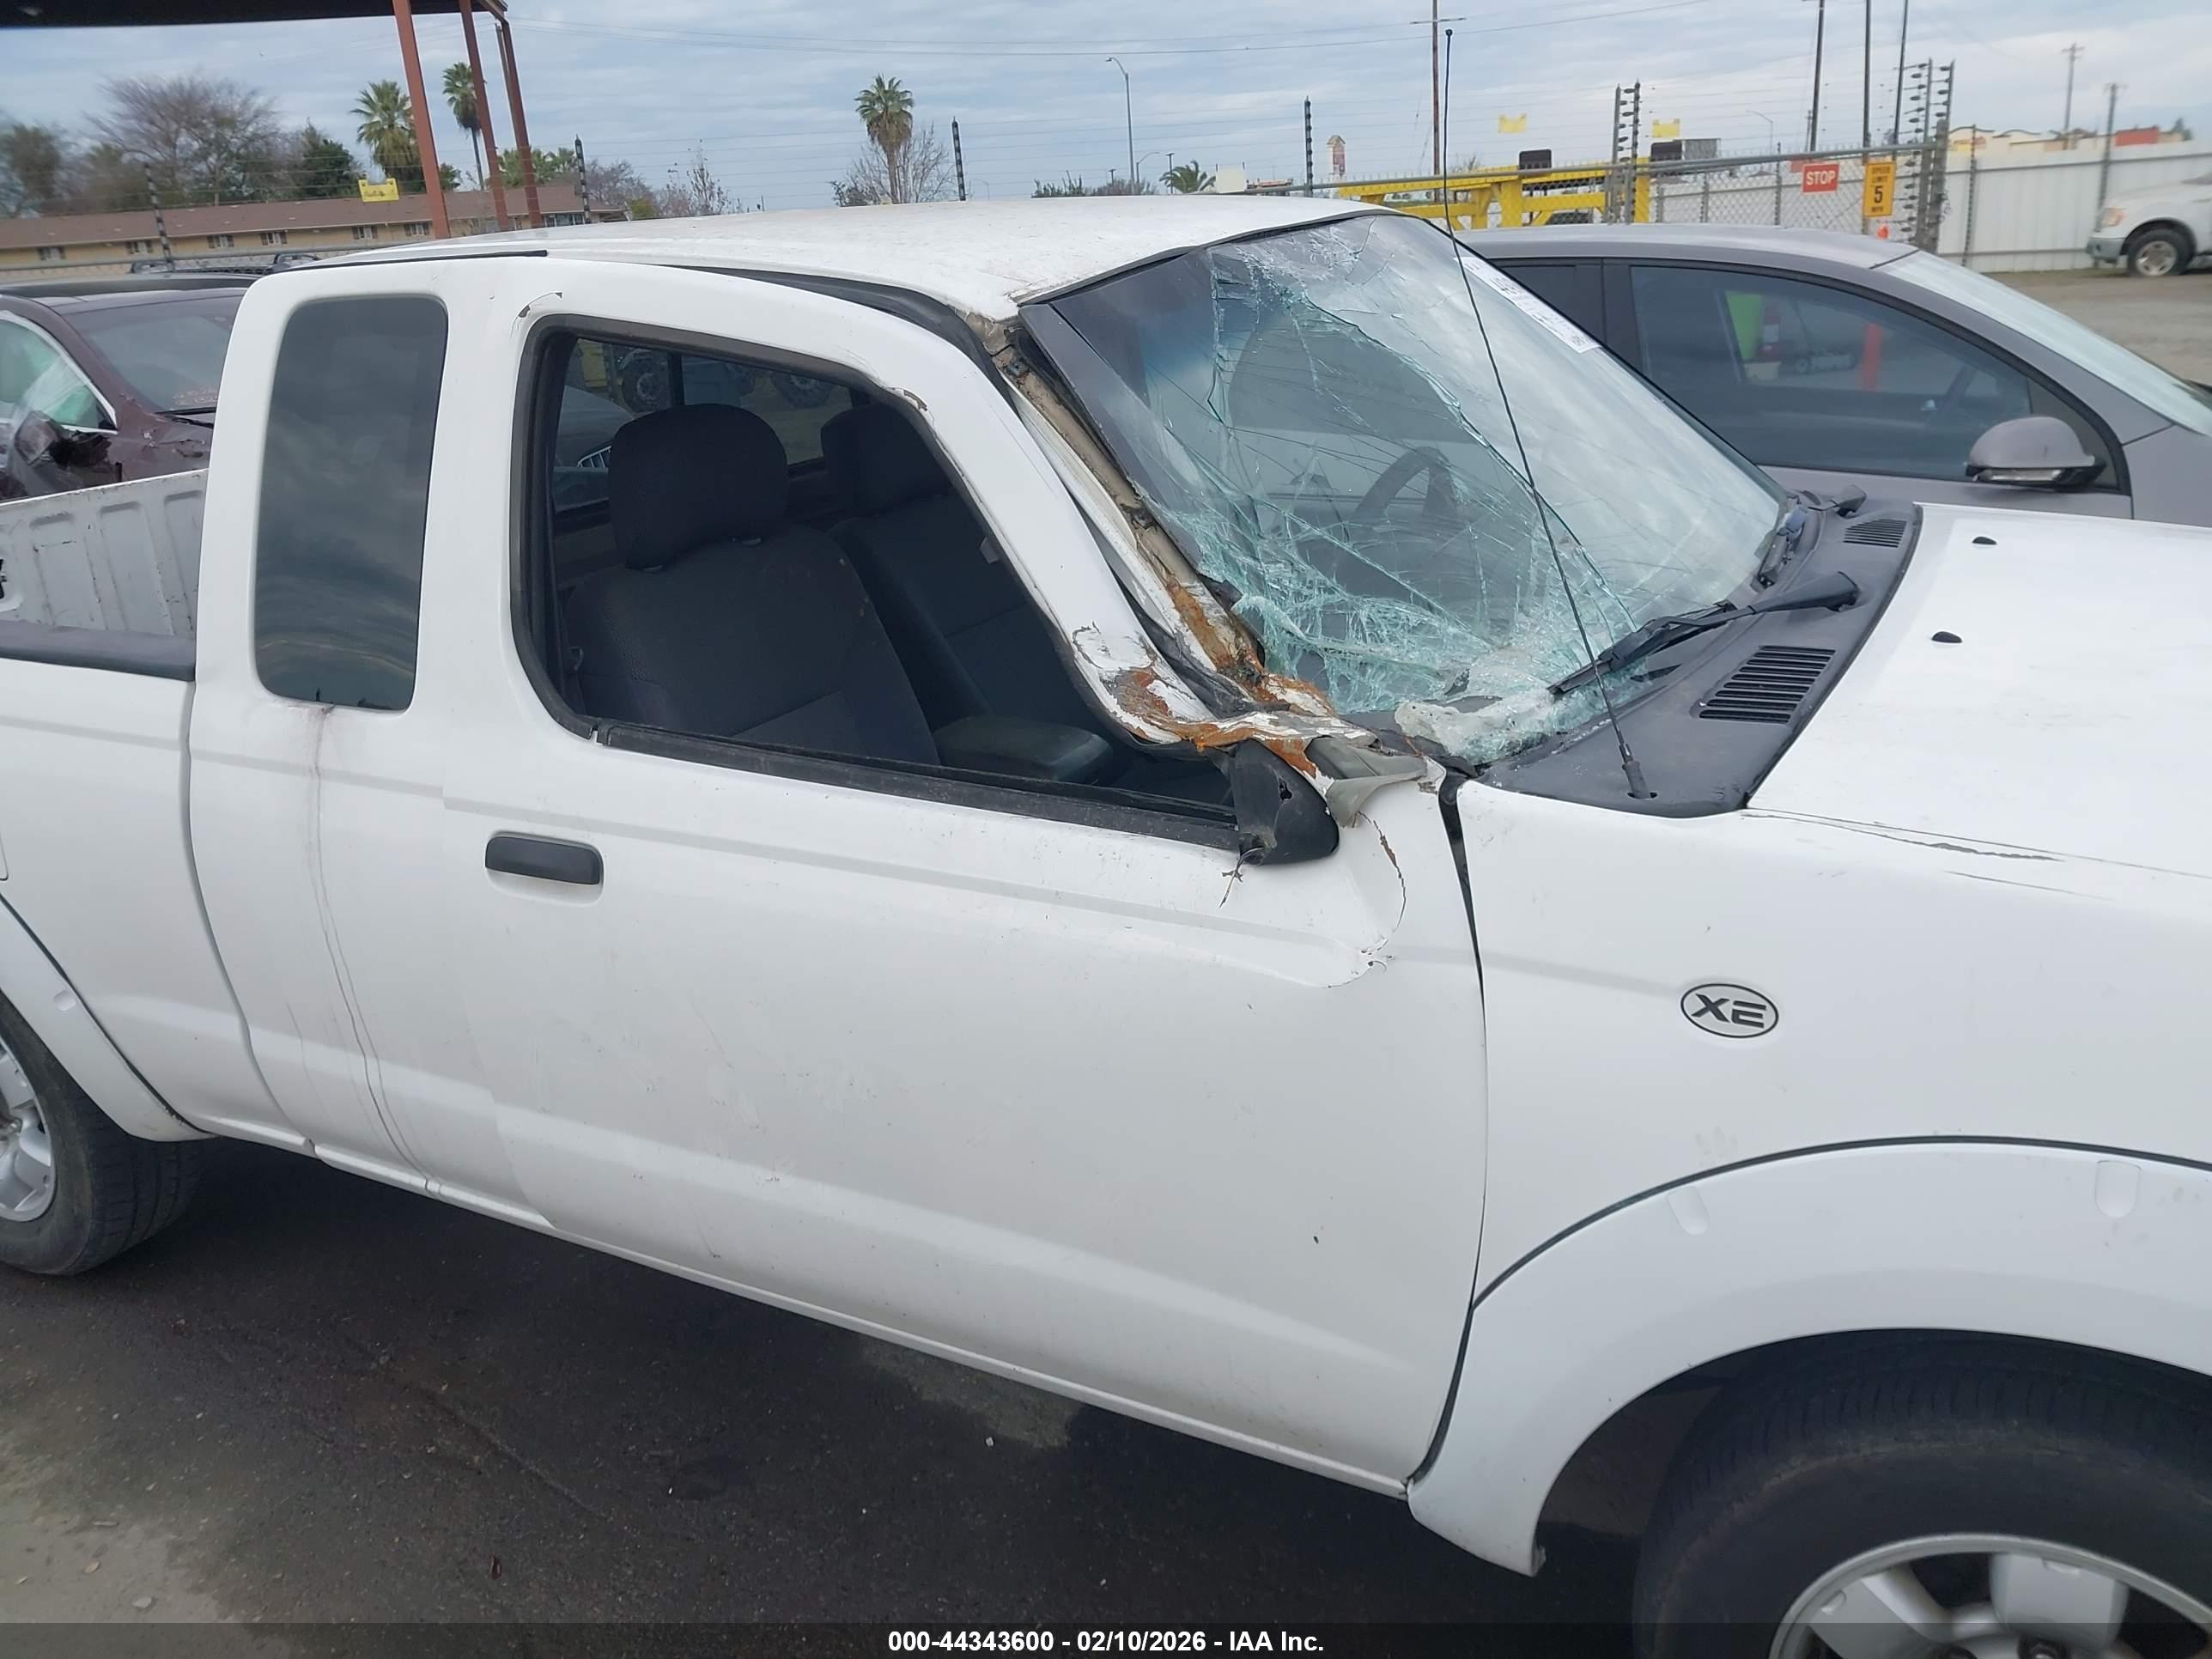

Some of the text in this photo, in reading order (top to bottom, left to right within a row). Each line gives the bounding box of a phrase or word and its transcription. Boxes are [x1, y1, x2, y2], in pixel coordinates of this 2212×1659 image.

[1806, 170, 1836, 186] STOP
[1874, 185, 1884, 204] 5
[1691, 993, 1767, 1029] XE
